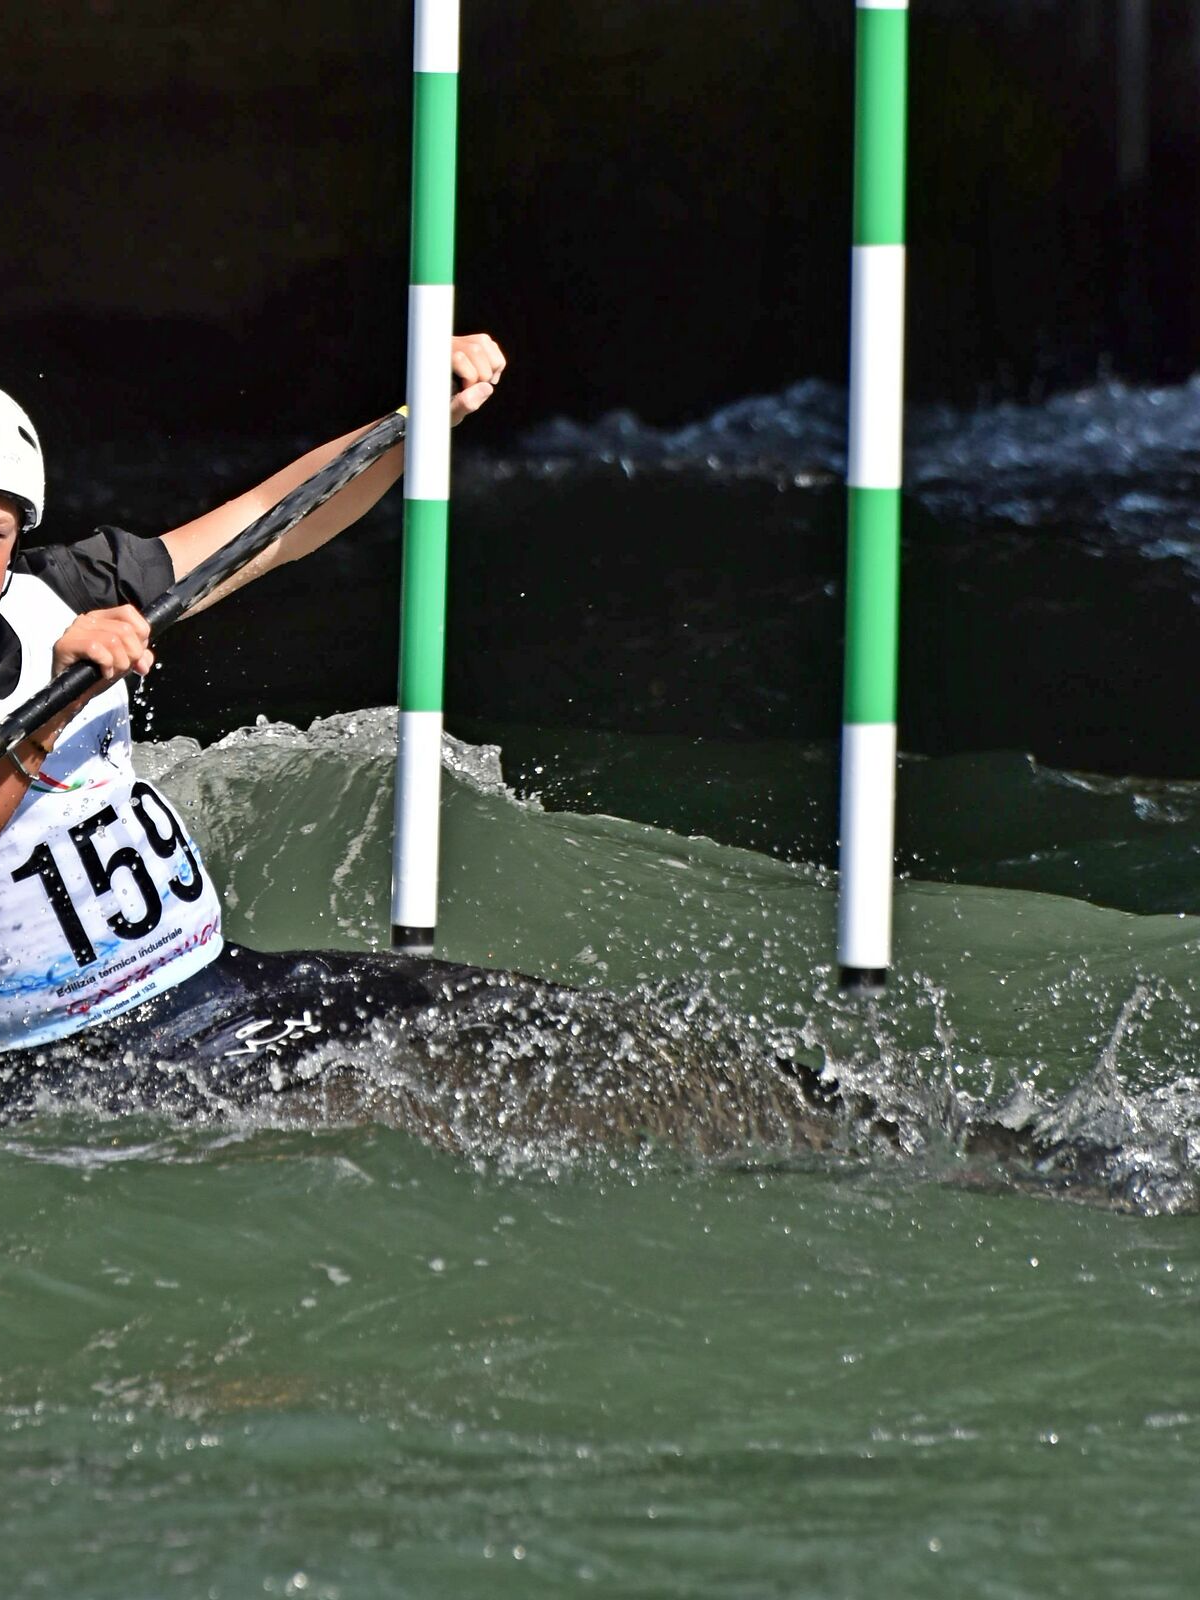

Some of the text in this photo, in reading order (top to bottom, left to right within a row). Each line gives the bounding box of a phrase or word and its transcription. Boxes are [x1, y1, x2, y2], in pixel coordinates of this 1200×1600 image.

[10, 781, 203, 968] 159
[56, 926, 183, 998] Edilizia termica industriale
[130, 991, 141, 1001] nel
